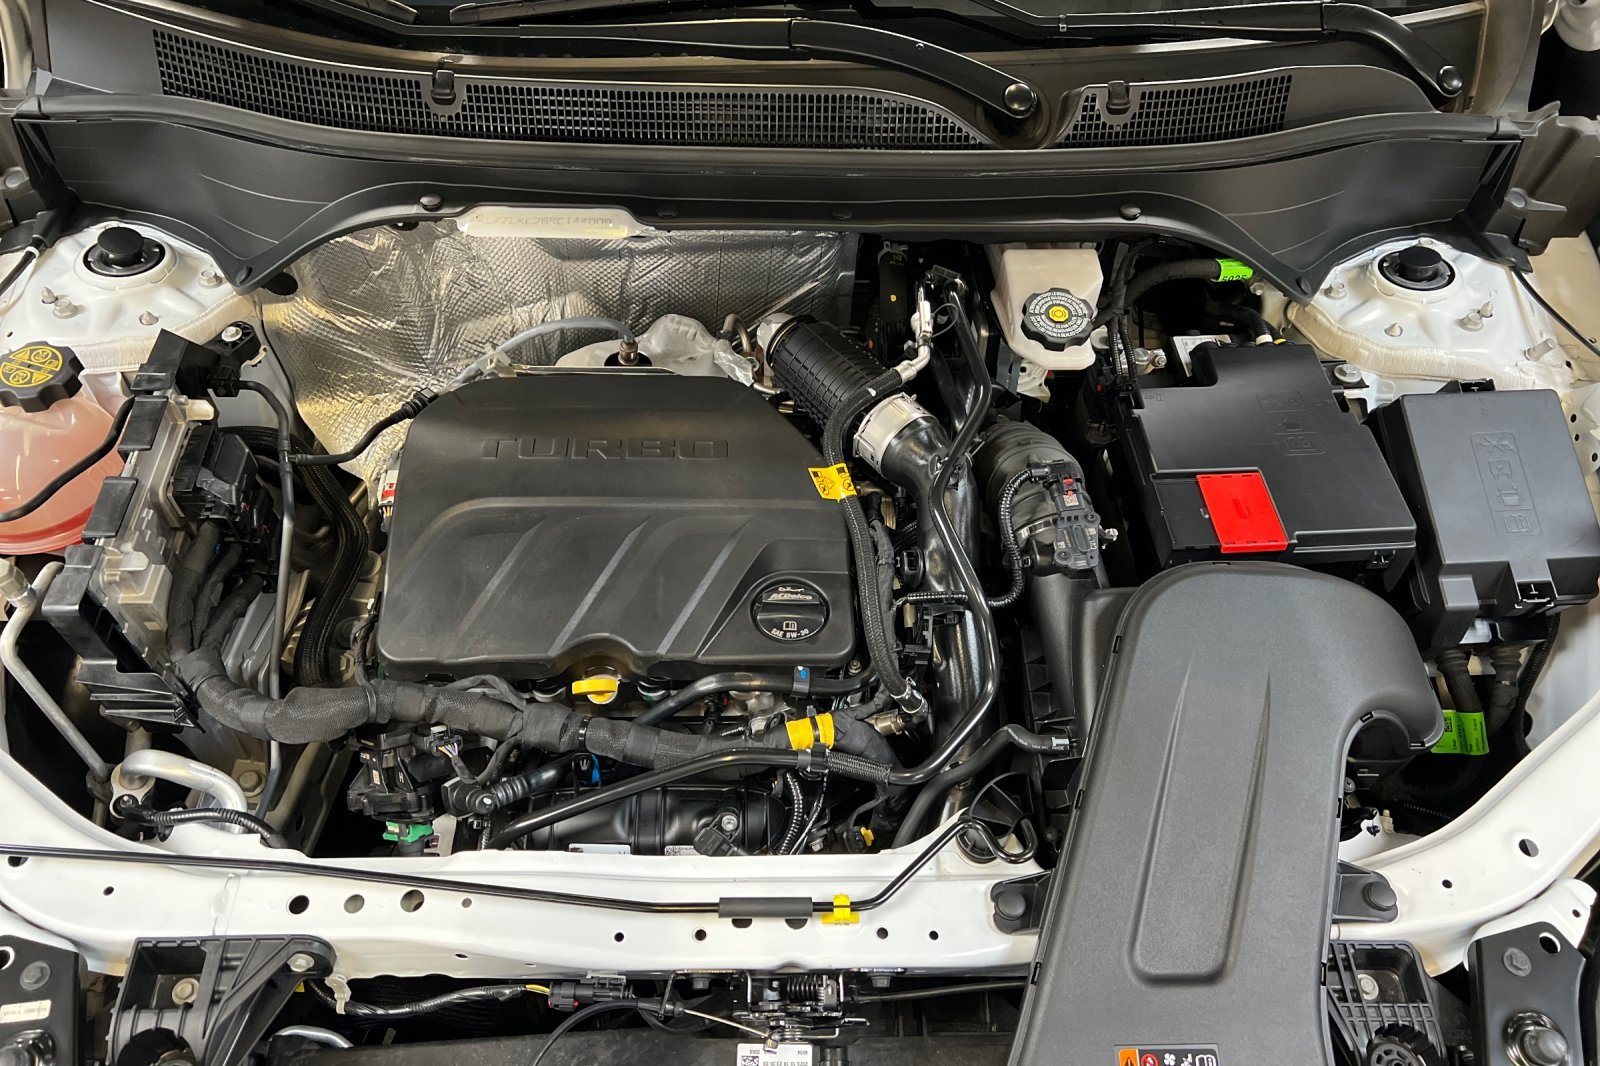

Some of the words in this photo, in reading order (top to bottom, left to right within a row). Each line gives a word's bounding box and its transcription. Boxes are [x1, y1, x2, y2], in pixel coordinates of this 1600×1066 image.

[480, 437, 729, 460] TURBO
[770, 628, 785, 638] SAE
[785, 628, 810, 639] 5W-30
